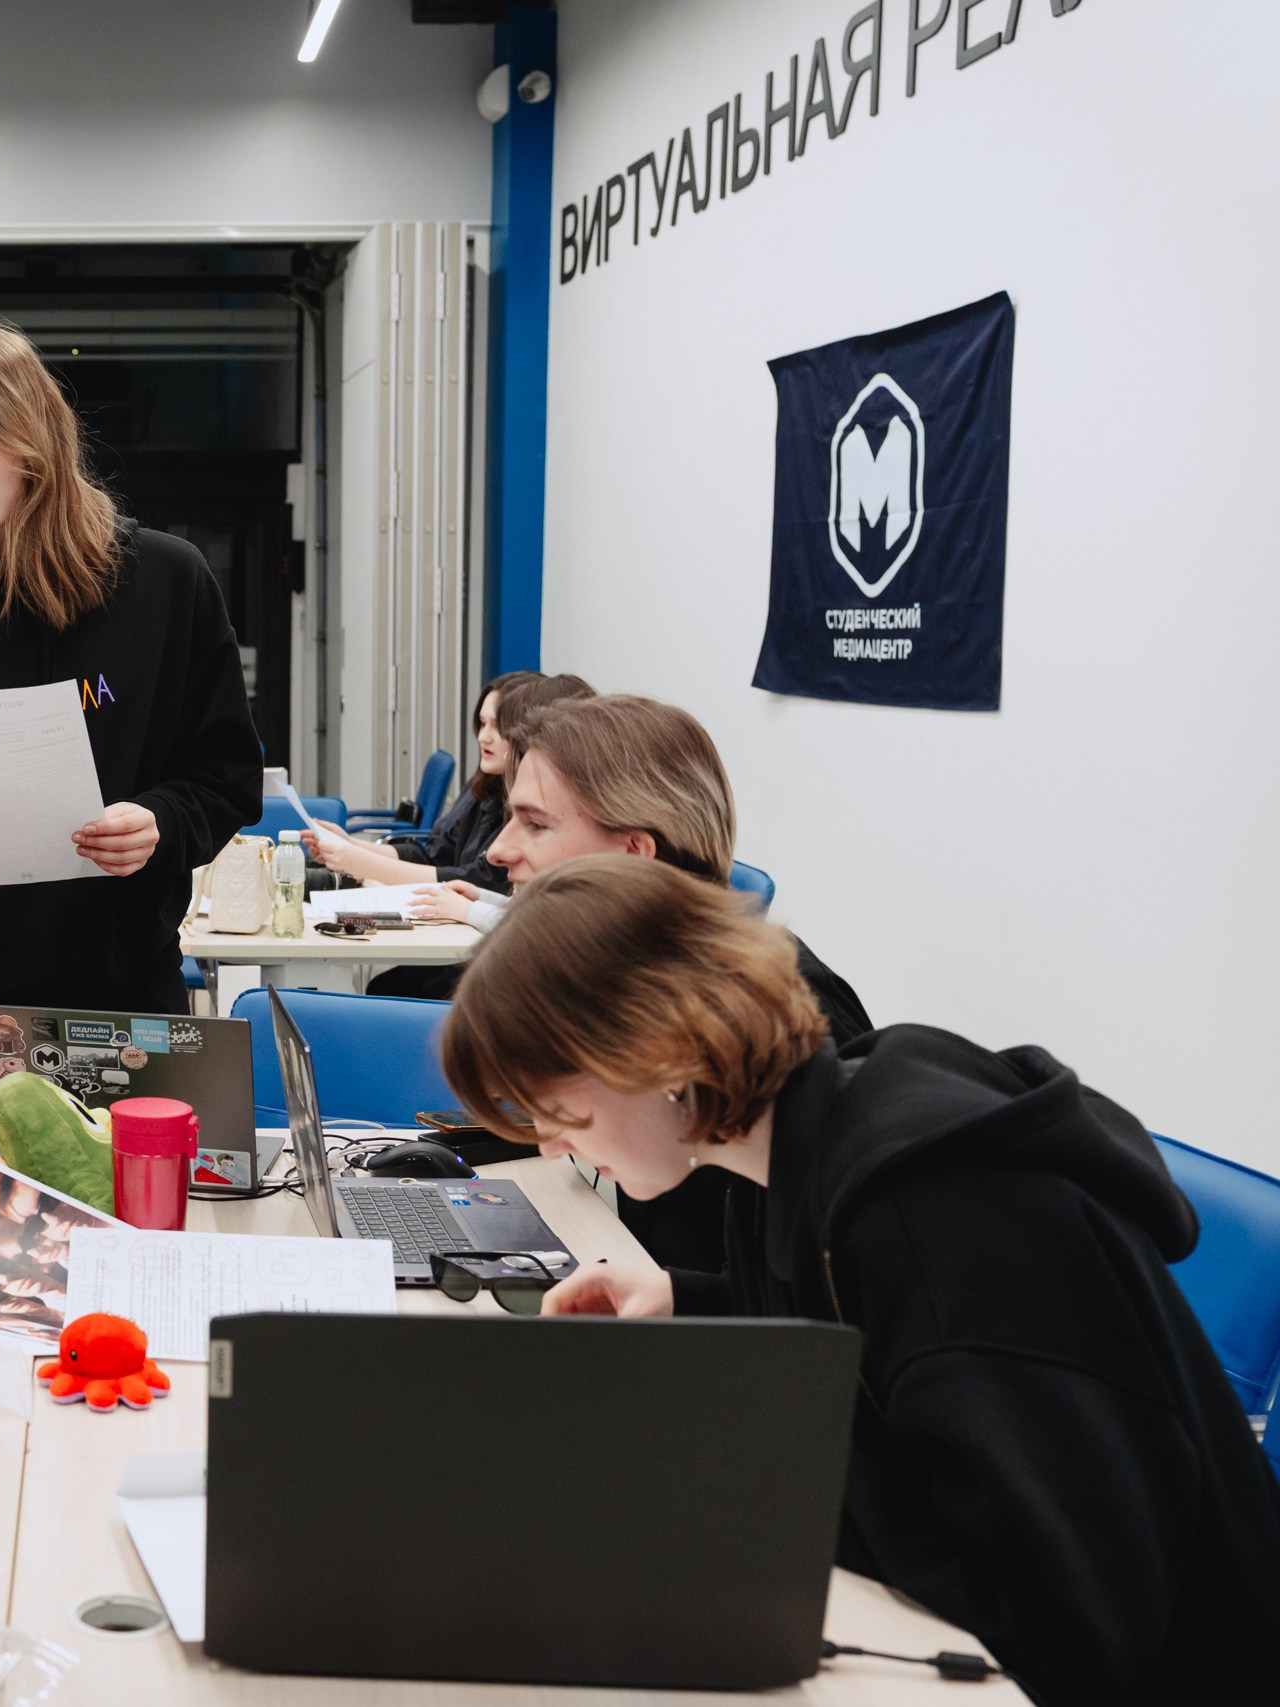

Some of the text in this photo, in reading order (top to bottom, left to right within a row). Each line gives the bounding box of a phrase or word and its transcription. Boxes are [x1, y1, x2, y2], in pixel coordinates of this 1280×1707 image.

[560, 0, 883, 285] ВИРТУАЛЬНАЯ
[825, 602, 921, 632] СТУДЕНЧЕСКИЙ
[833, 638, 913, 662] МЕДИАЦЕНТР
[70, 1025, 110, 1034] ДЕДЛАЙН
